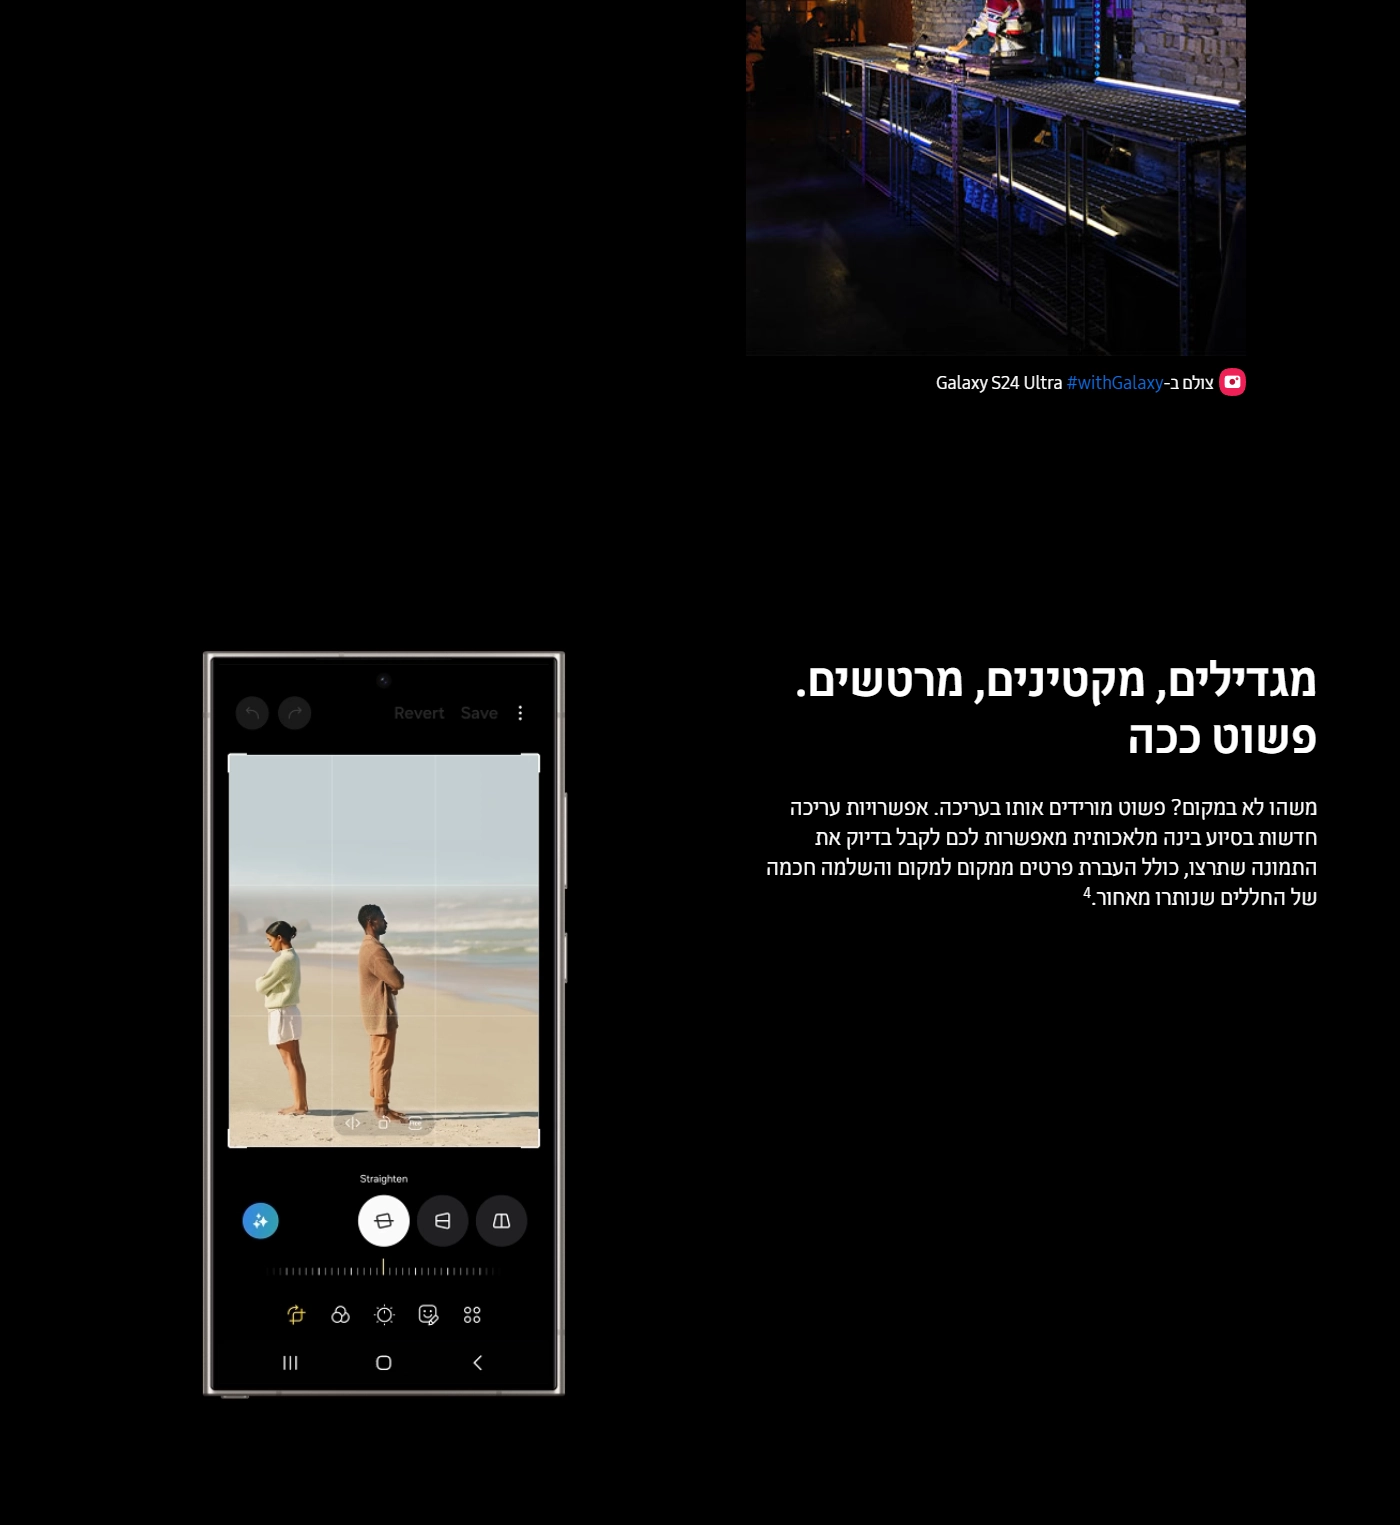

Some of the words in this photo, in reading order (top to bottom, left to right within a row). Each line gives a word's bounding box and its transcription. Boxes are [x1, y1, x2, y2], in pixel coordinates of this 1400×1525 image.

[394, 706, 445, 720] Revert
[461, 706, 499, 720] Save
[359, 1174, 409, 1186] Straighten
